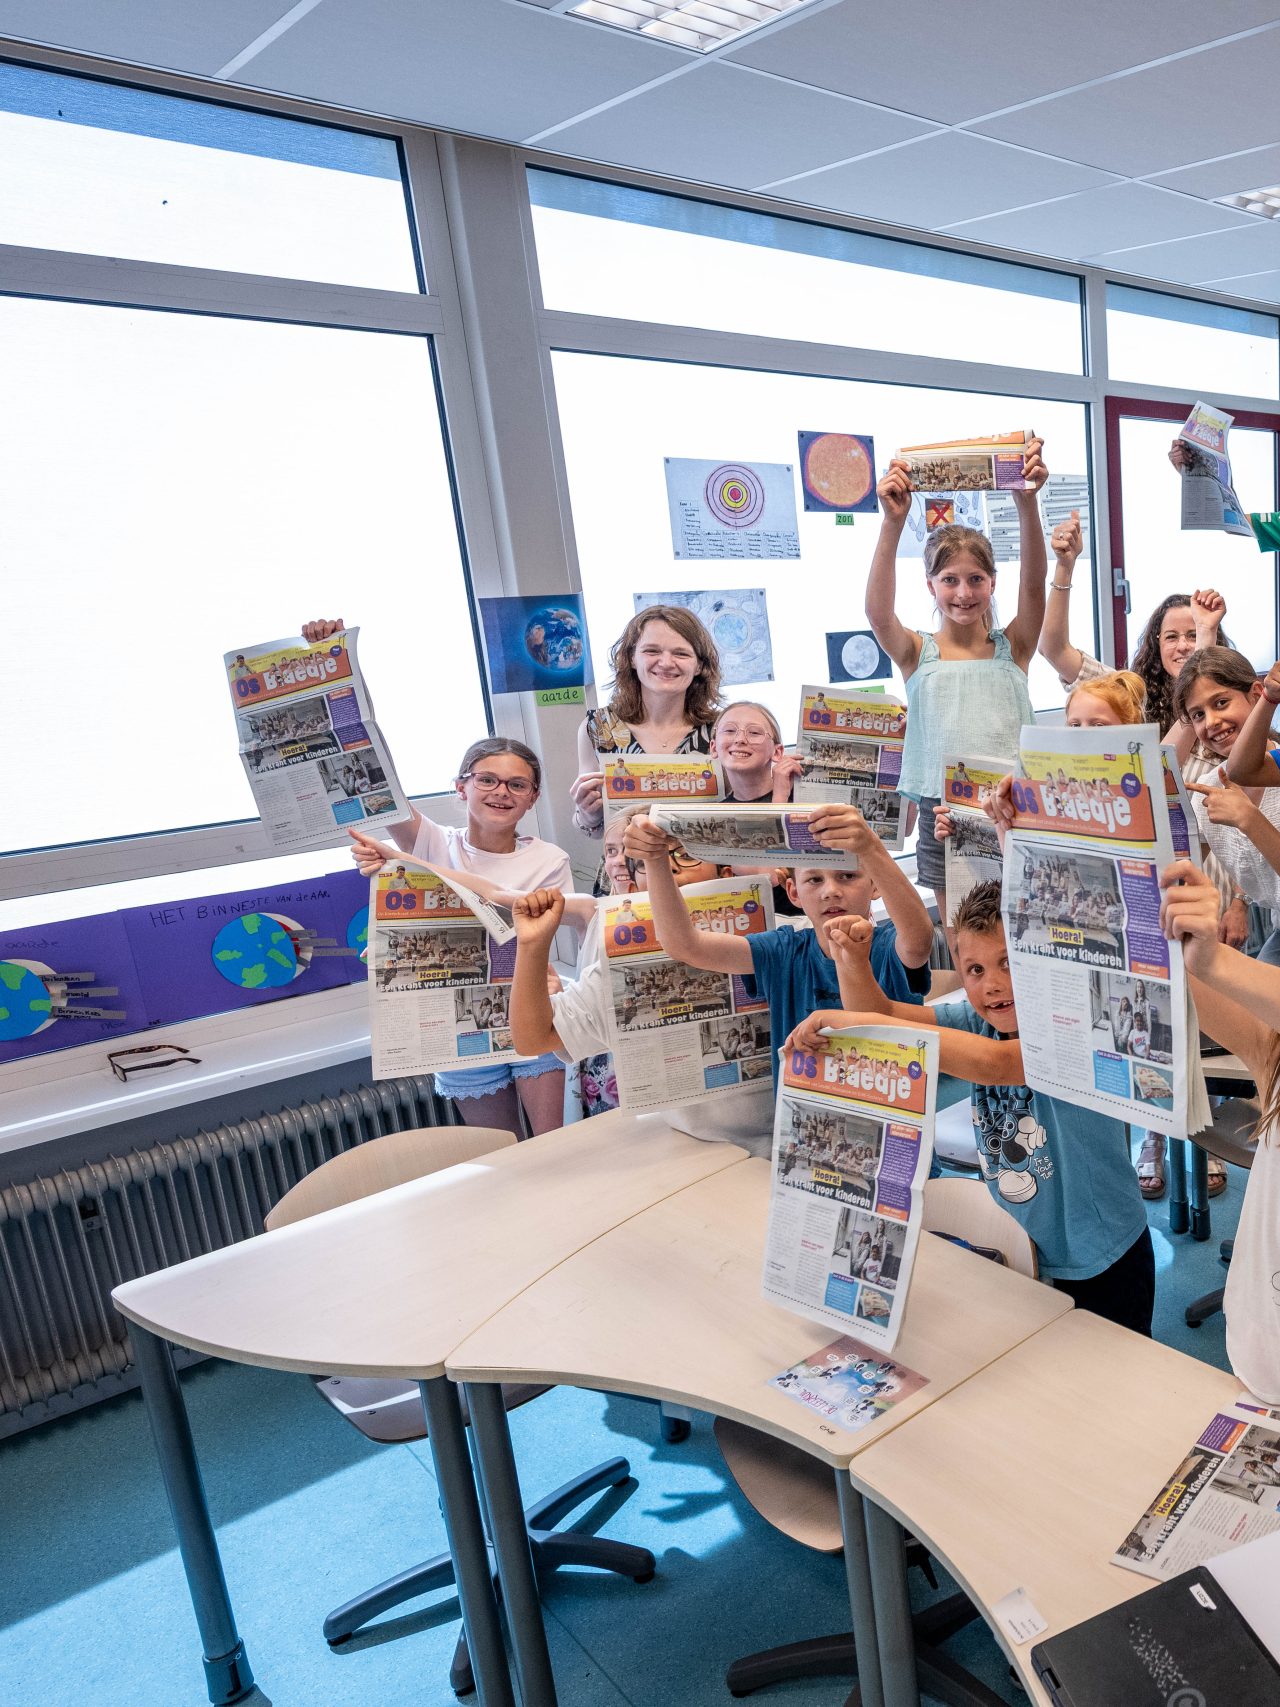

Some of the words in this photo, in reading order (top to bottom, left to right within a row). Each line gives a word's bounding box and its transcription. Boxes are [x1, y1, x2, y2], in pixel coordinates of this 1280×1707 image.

[838, 515, 853, 524] zon
[236, 679, 260, 697] Os
[542, 689, 579, 702] aarde
[810, 710, 830, 725] Os
[282, 744, 306, 756] Hoera!
[289, 753, 304, 764] voor
[306, 746, 337, 759] kinderen
[612, 778, 635, 792] Os
[952, 781, 973, 798] Os
[1012, 781, 1038, 814] Os
[386, 892, 416, 910] Os
[150, 907, 184, 928] HET
[614, 925, 647, 945] Os
[1052, 928, 1081, 942] Hoera!
[1030, 940, 1055, 956] krant
[1057, 946, 1077, 959] voor
[1079, 949, 1122, 967] kinderen
[660, 1005, 692, 1015] Hoera!
[667, 1015, 687, 1024] voor
[689, 1007, 729, 1020] kinderen
[792, 1051, 817, 1078] Os
[814, 1170, 840, 1184] Hoera!
[816, 1182, 834, 1197] voor
[835, 1187, 870, 1208] kinderen
[1157, 1484, 1184, 1515] Hoera!
[1159, 1512, 1178, 1538] krant
[1174, 1491, 1193, 1515] voor
[1189, 1458, 1221, 1493] kinderen
